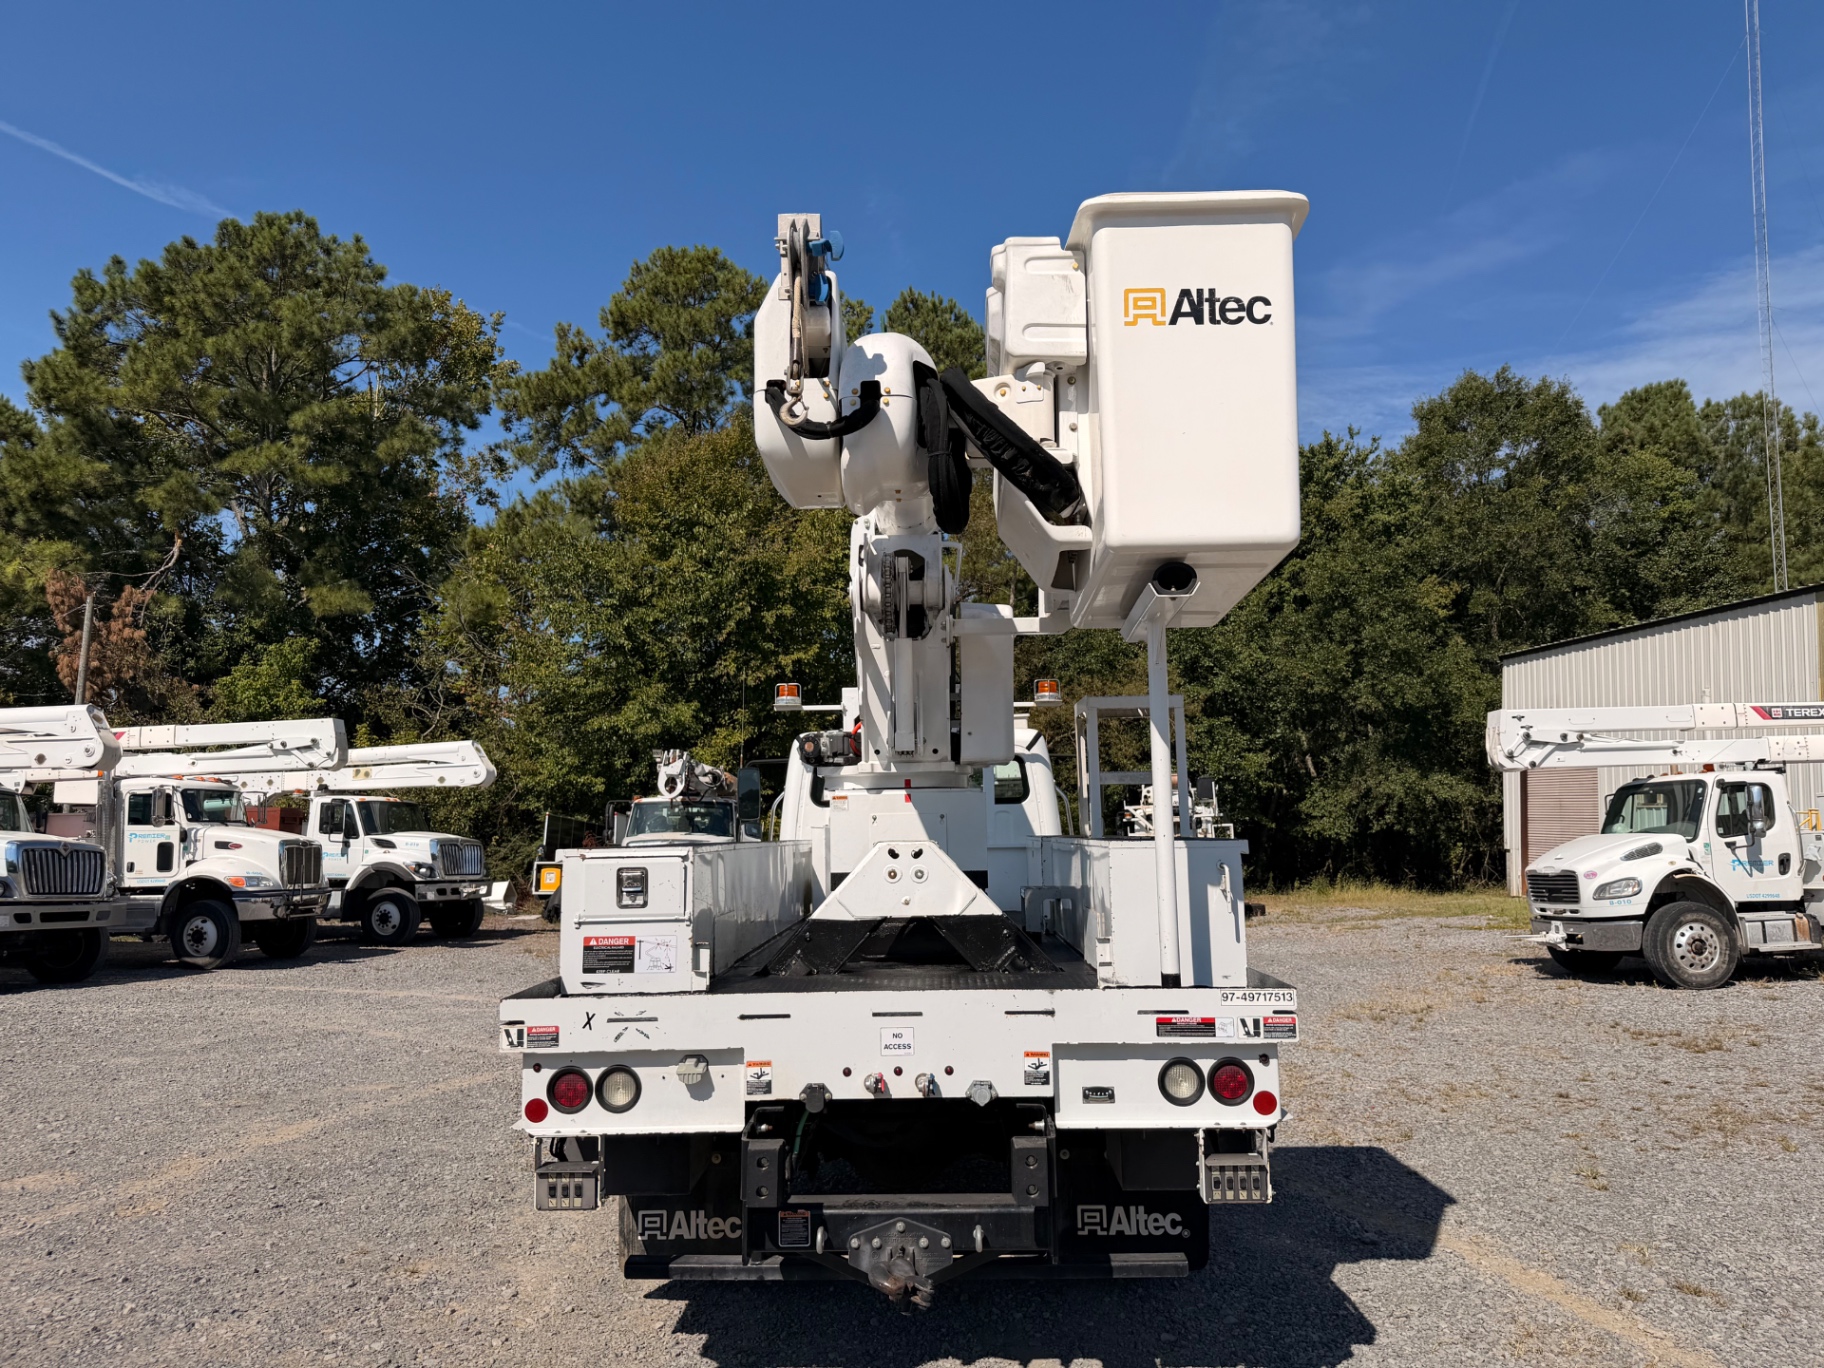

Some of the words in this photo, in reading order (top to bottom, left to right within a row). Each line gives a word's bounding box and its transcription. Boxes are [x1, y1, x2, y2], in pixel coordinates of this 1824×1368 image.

[1168, 287, 1272, 325] Altec
[1785, 708, 1824, 717] TEREX
[1221, 991, 1293, 1002] 97-49717513
[668, 1210, 742, 1240] Altec
[1108, 1205, 1183, 1235] Altec
